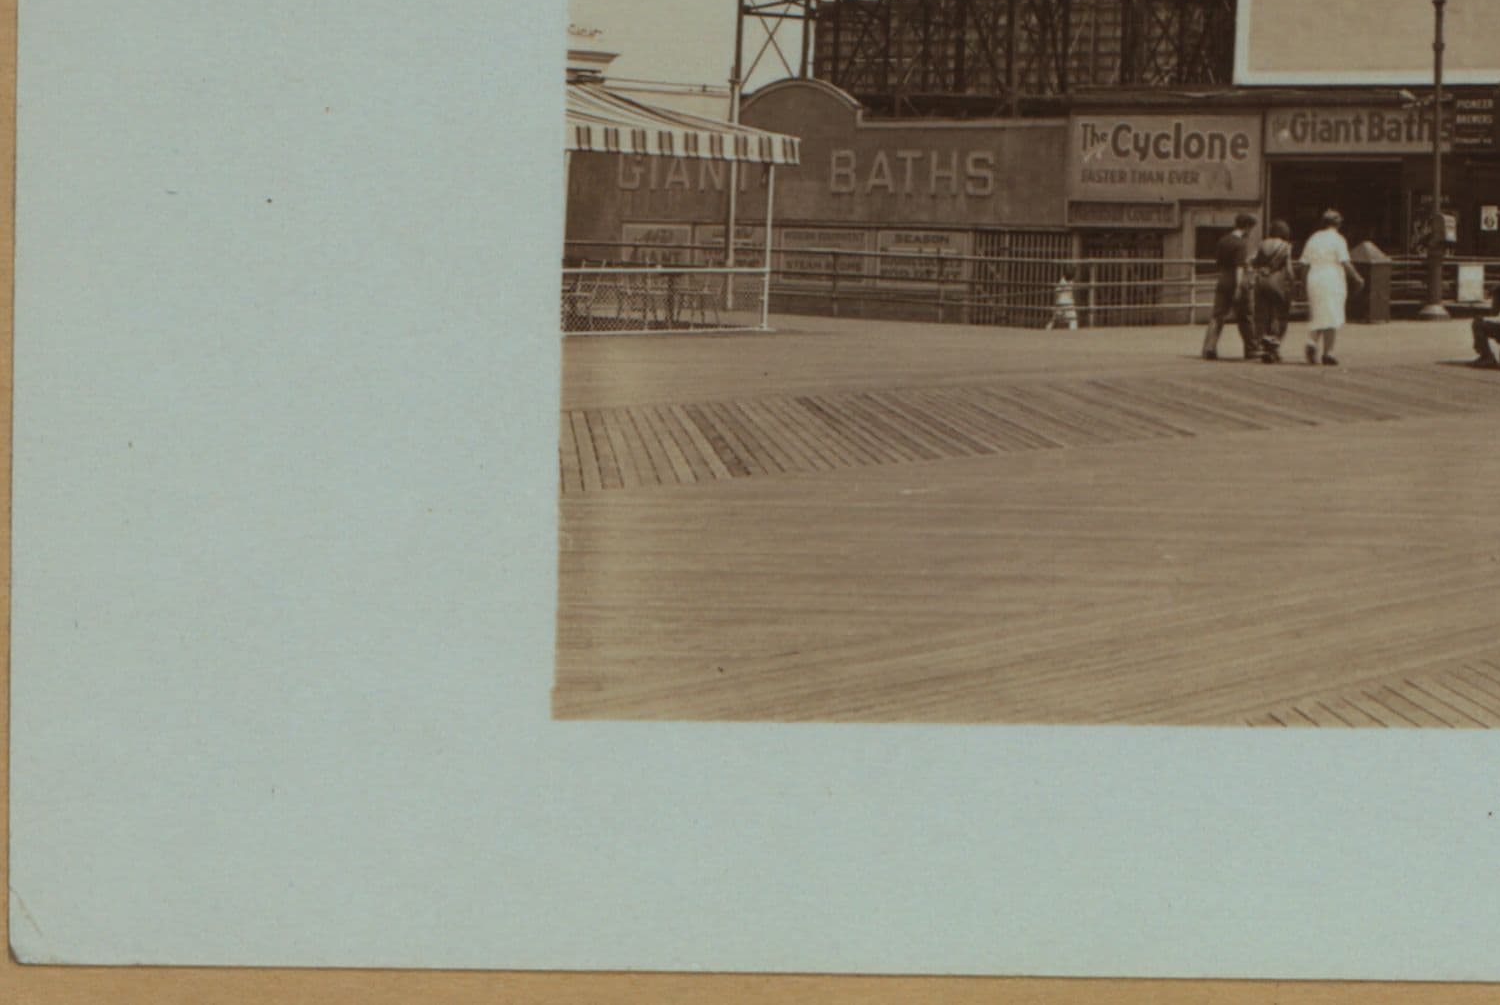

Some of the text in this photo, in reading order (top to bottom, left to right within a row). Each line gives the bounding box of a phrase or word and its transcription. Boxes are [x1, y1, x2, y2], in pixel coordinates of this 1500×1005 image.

[1080, 122, 1251, 162] The Cyclone
[1289, 111, 1364, 144] Giant
[1367, 109, 1454, 143] Baths
[829, 149, 997, 198] BATHS
[1081, 167, 1200, 185] FASTER THAN EVER
[893, 233, 951, 244] SEASON
